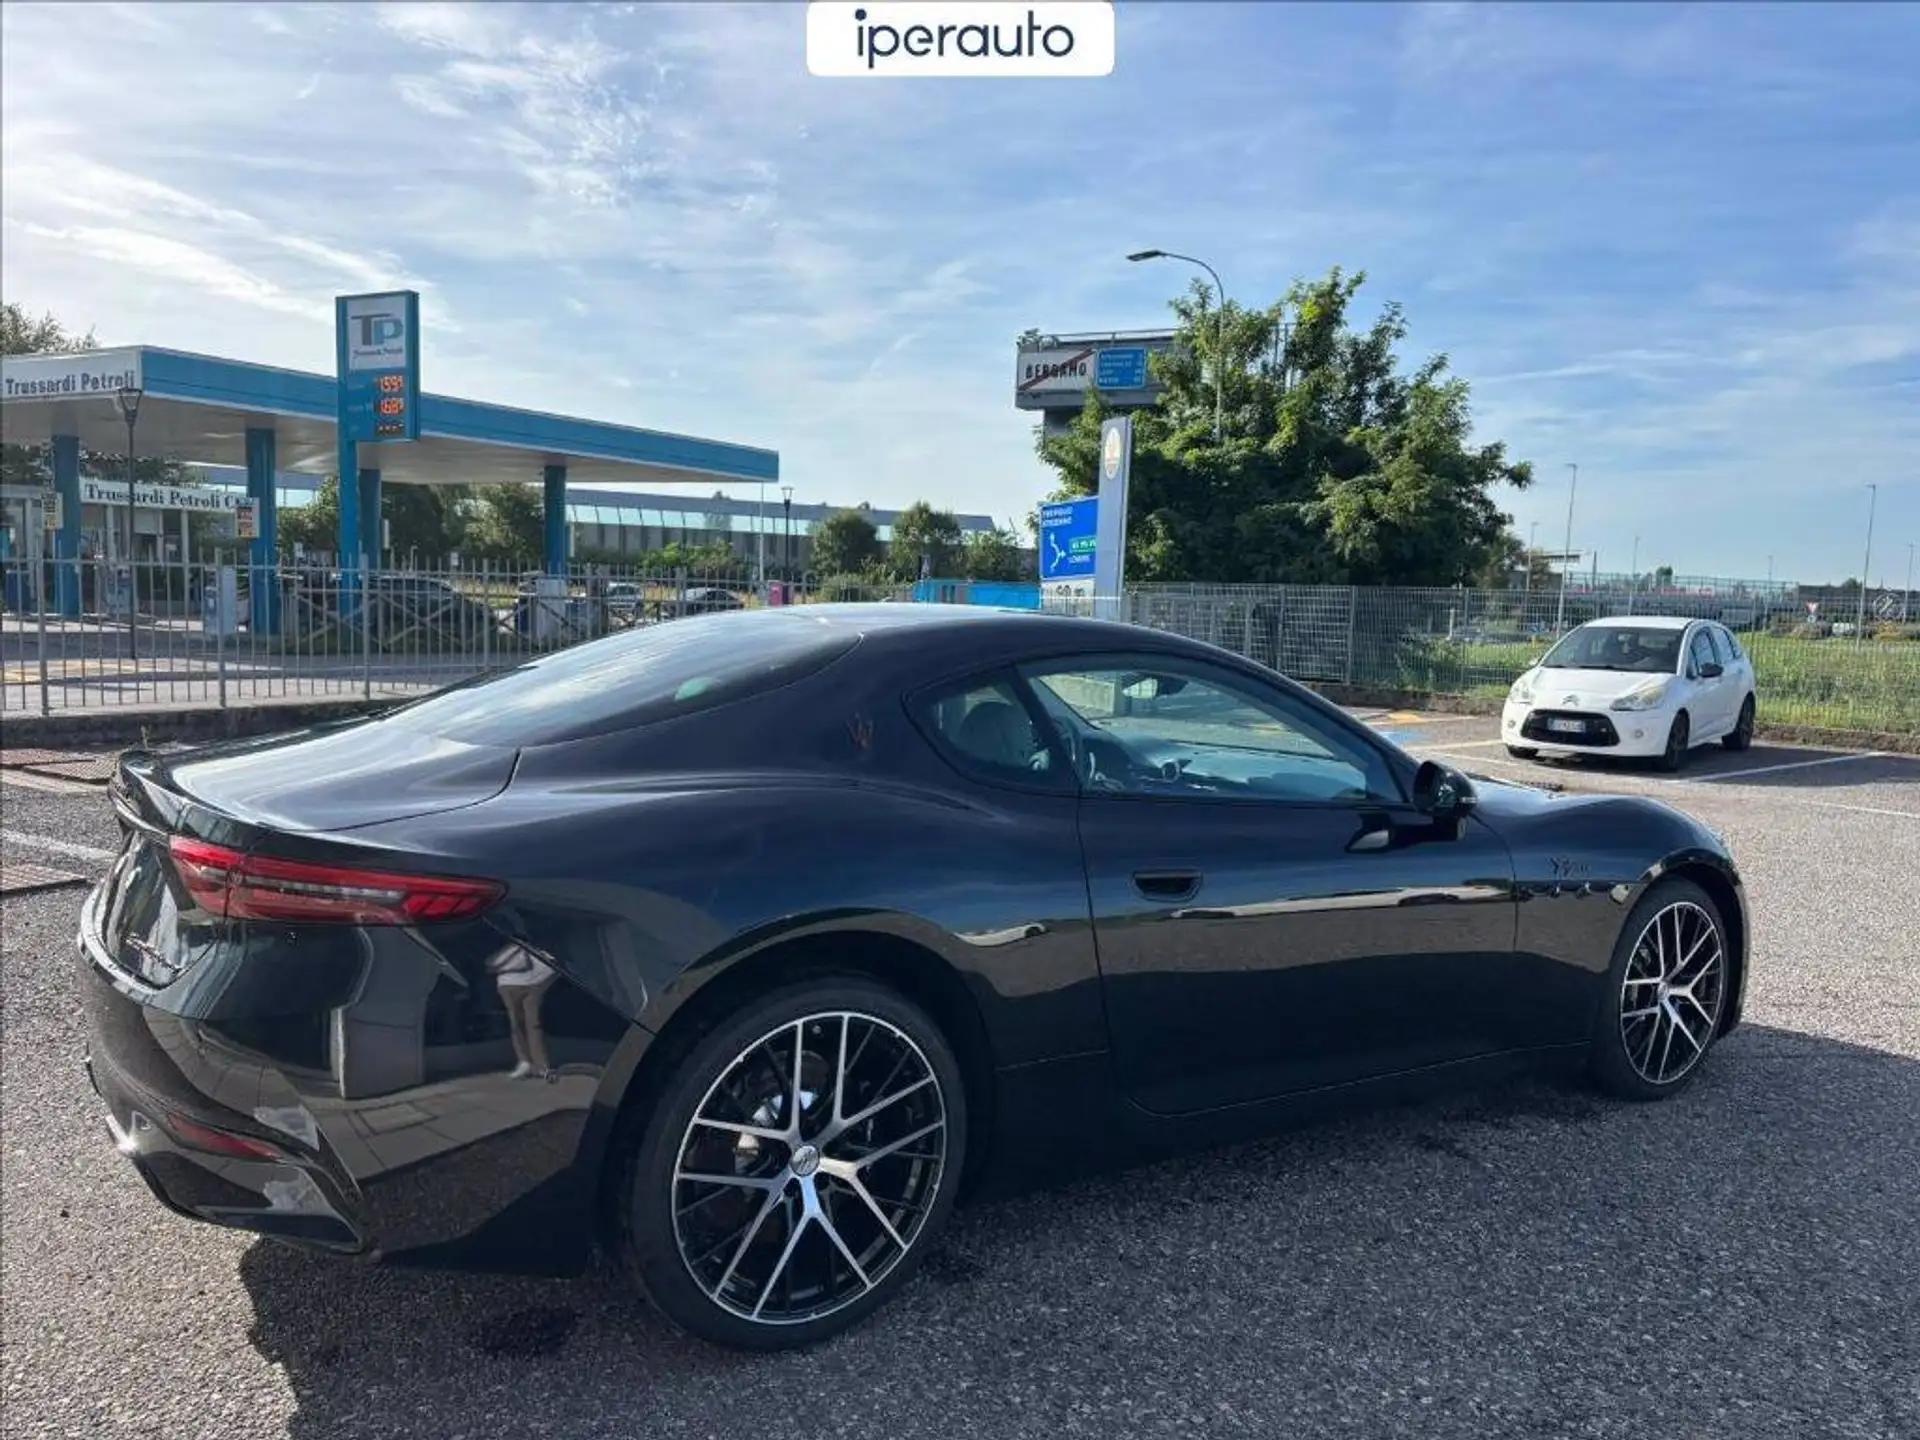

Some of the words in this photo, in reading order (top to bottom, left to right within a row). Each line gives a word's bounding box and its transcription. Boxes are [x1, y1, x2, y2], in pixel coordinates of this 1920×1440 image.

[6, 374, 76, 395] Trussardi
[81, 370, 135, 391] Petroli
[170, 491, 221, 509] Petroli
